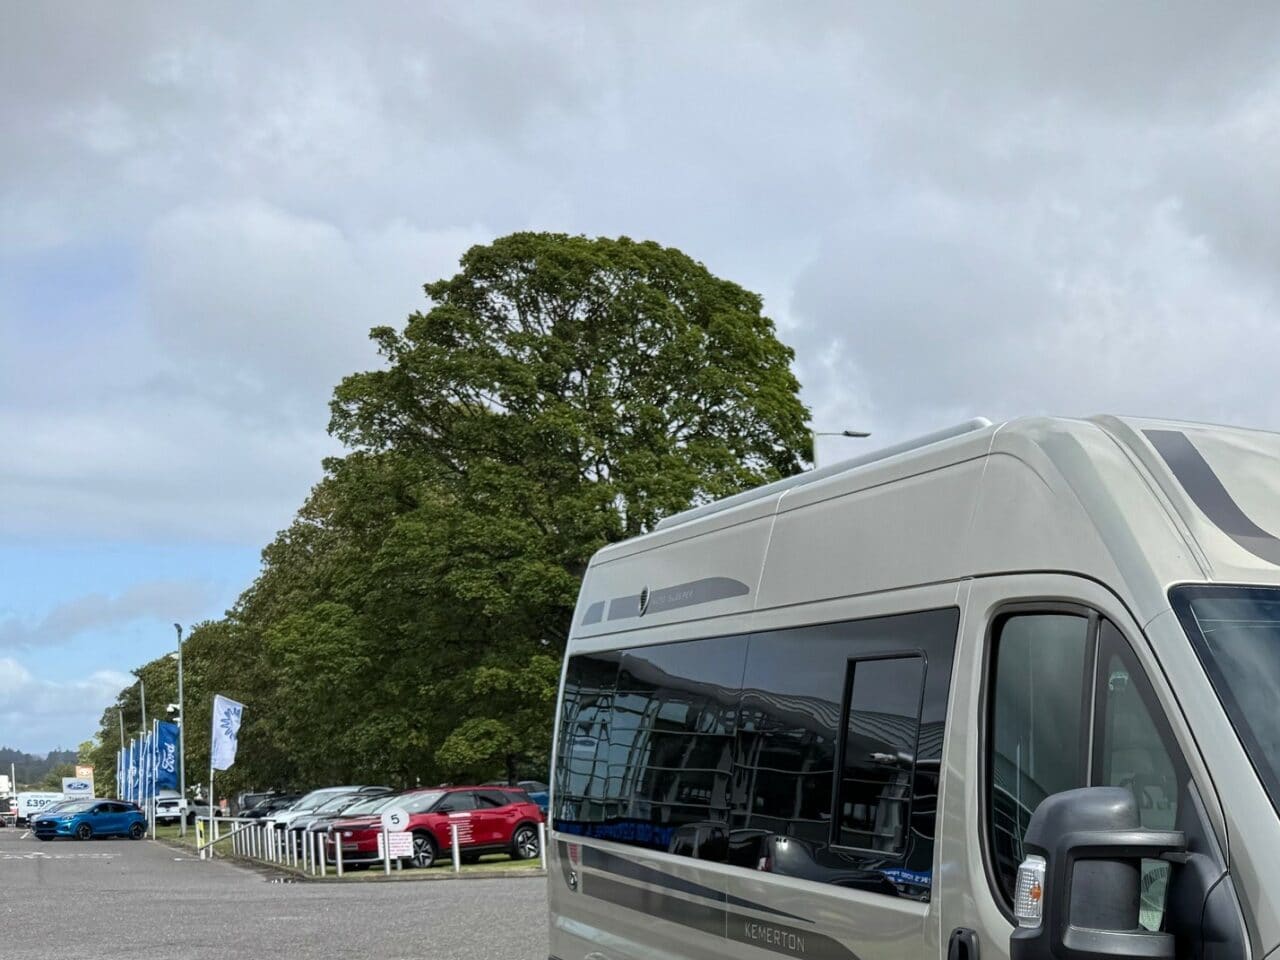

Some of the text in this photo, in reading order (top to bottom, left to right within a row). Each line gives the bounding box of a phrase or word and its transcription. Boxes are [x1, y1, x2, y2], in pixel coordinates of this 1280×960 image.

[162, 742, 175, 773] Ford
[390, 812, 400, 825] 5
[744, 919, 805, 953] KEMERTON
